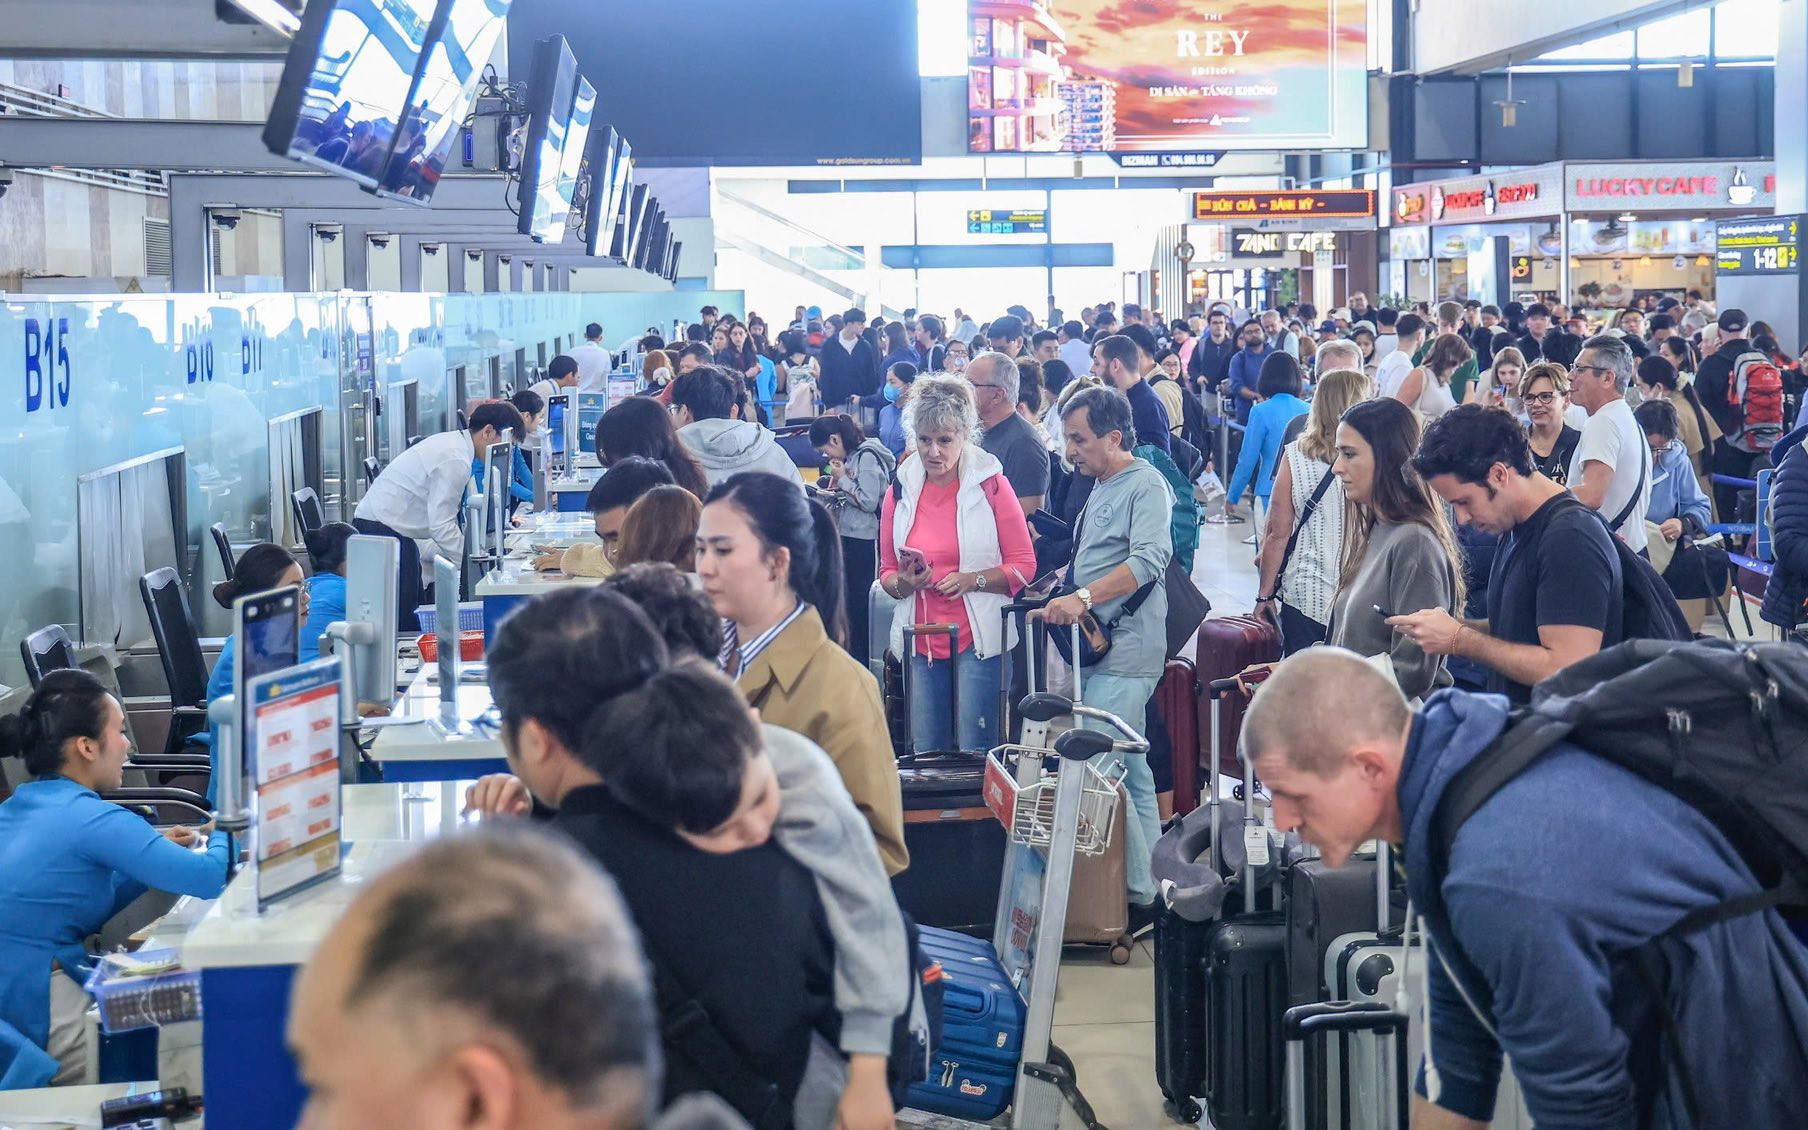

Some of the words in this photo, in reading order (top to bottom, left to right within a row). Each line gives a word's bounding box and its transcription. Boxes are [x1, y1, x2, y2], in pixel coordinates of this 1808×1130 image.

[1203, 13, 1222, 22] THE
[1177, 29, 1250, 57] REY
[1192, 67, 1236, 76] EDITION
[1149, 87, 1163, 97] DI
[1576, 177, 1652, 197] LUCKY
[1654, 176, 1718, 196] CAFE
[1287, 231, 1336, 254] CAFE
[1753, 247, 1778, 269] 1-12
[25, 318, 71, 412] B15
